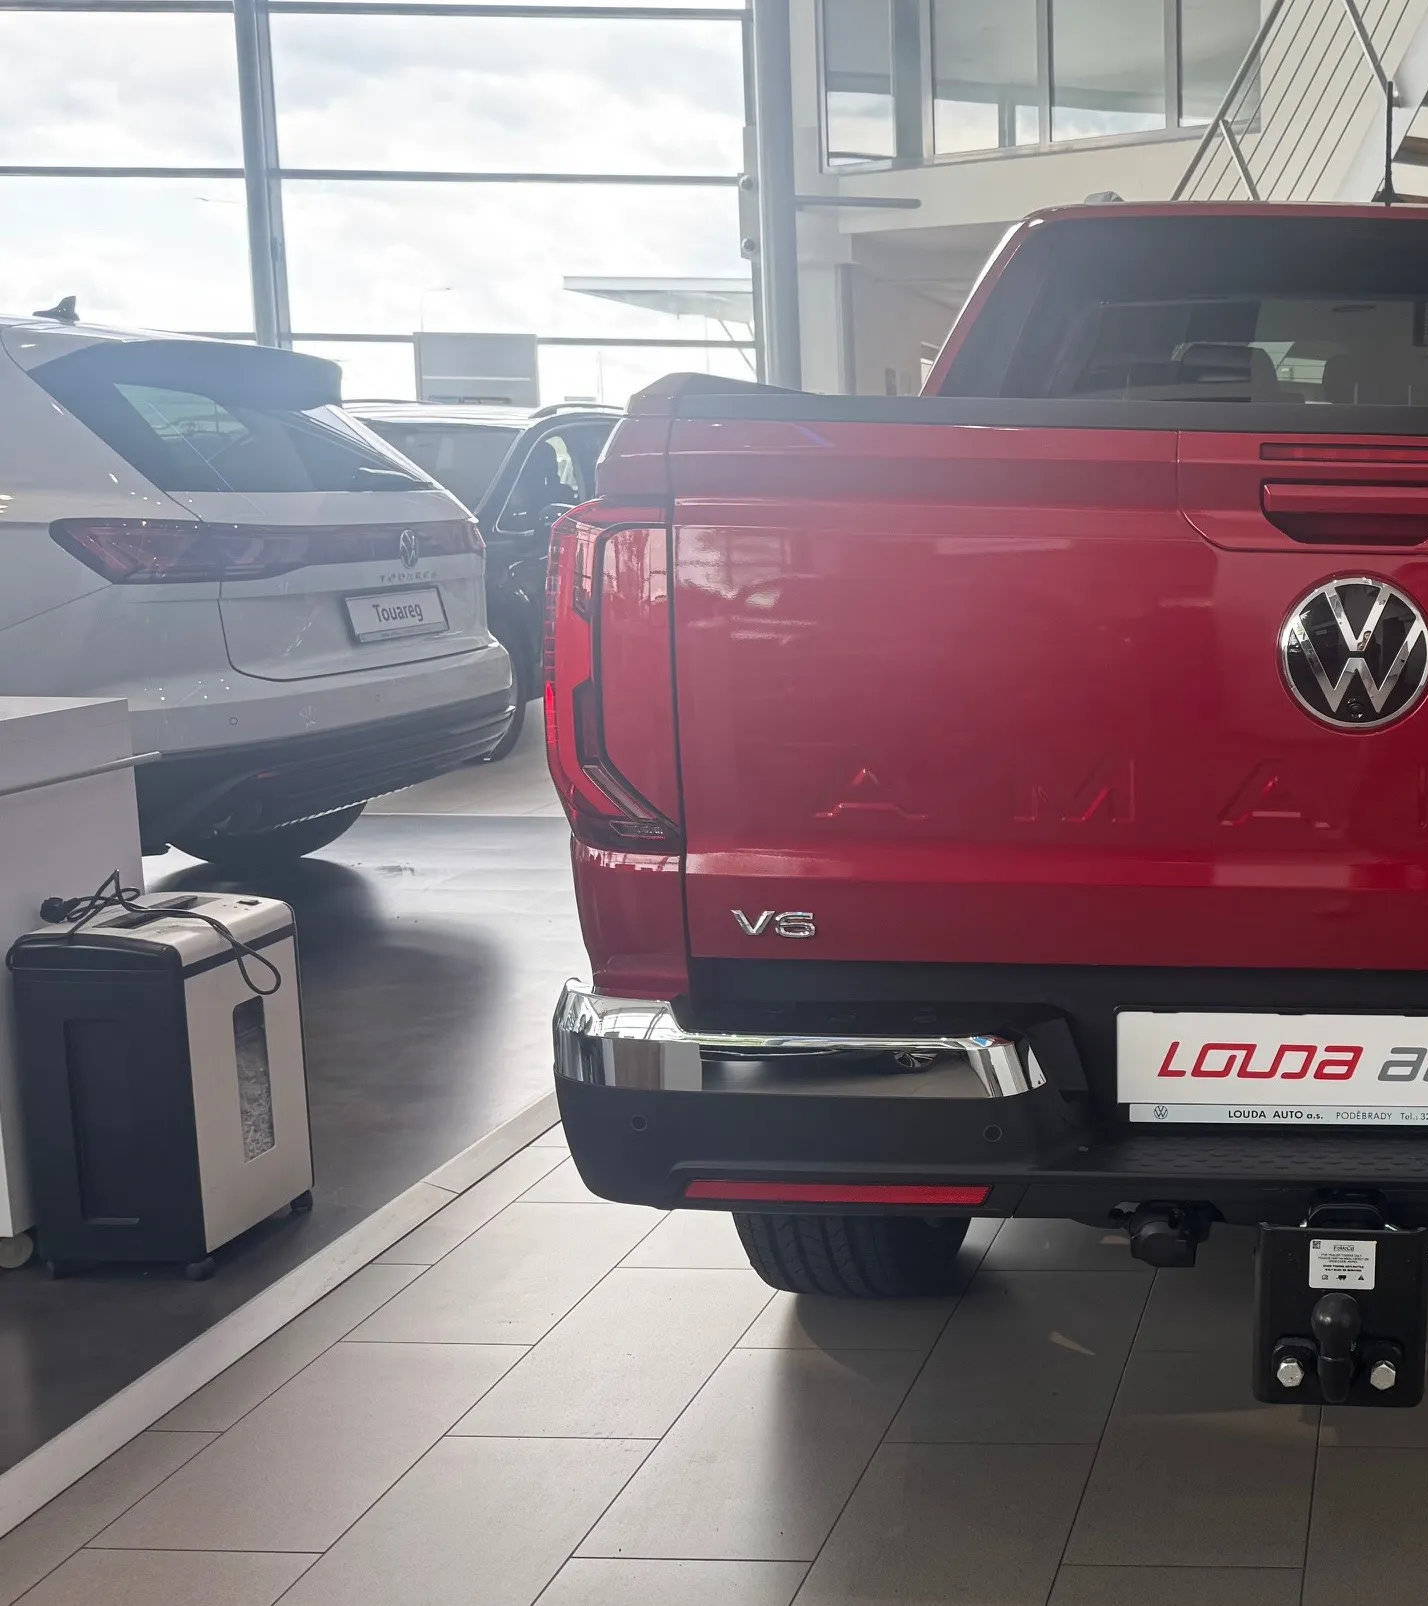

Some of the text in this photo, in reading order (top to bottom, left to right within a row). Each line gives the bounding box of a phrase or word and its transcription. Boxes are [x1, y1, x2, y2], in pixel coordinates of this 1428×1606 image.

[372, 603, 424, 622] Touareg
[731, 910, 816, 938] V6
[1228, 1110, 1267, 1119] LOUDA
[1273, 1110, 1304, 1119] AUTO
[1336, 1110, 1392, 1121] PODĚBRADY
